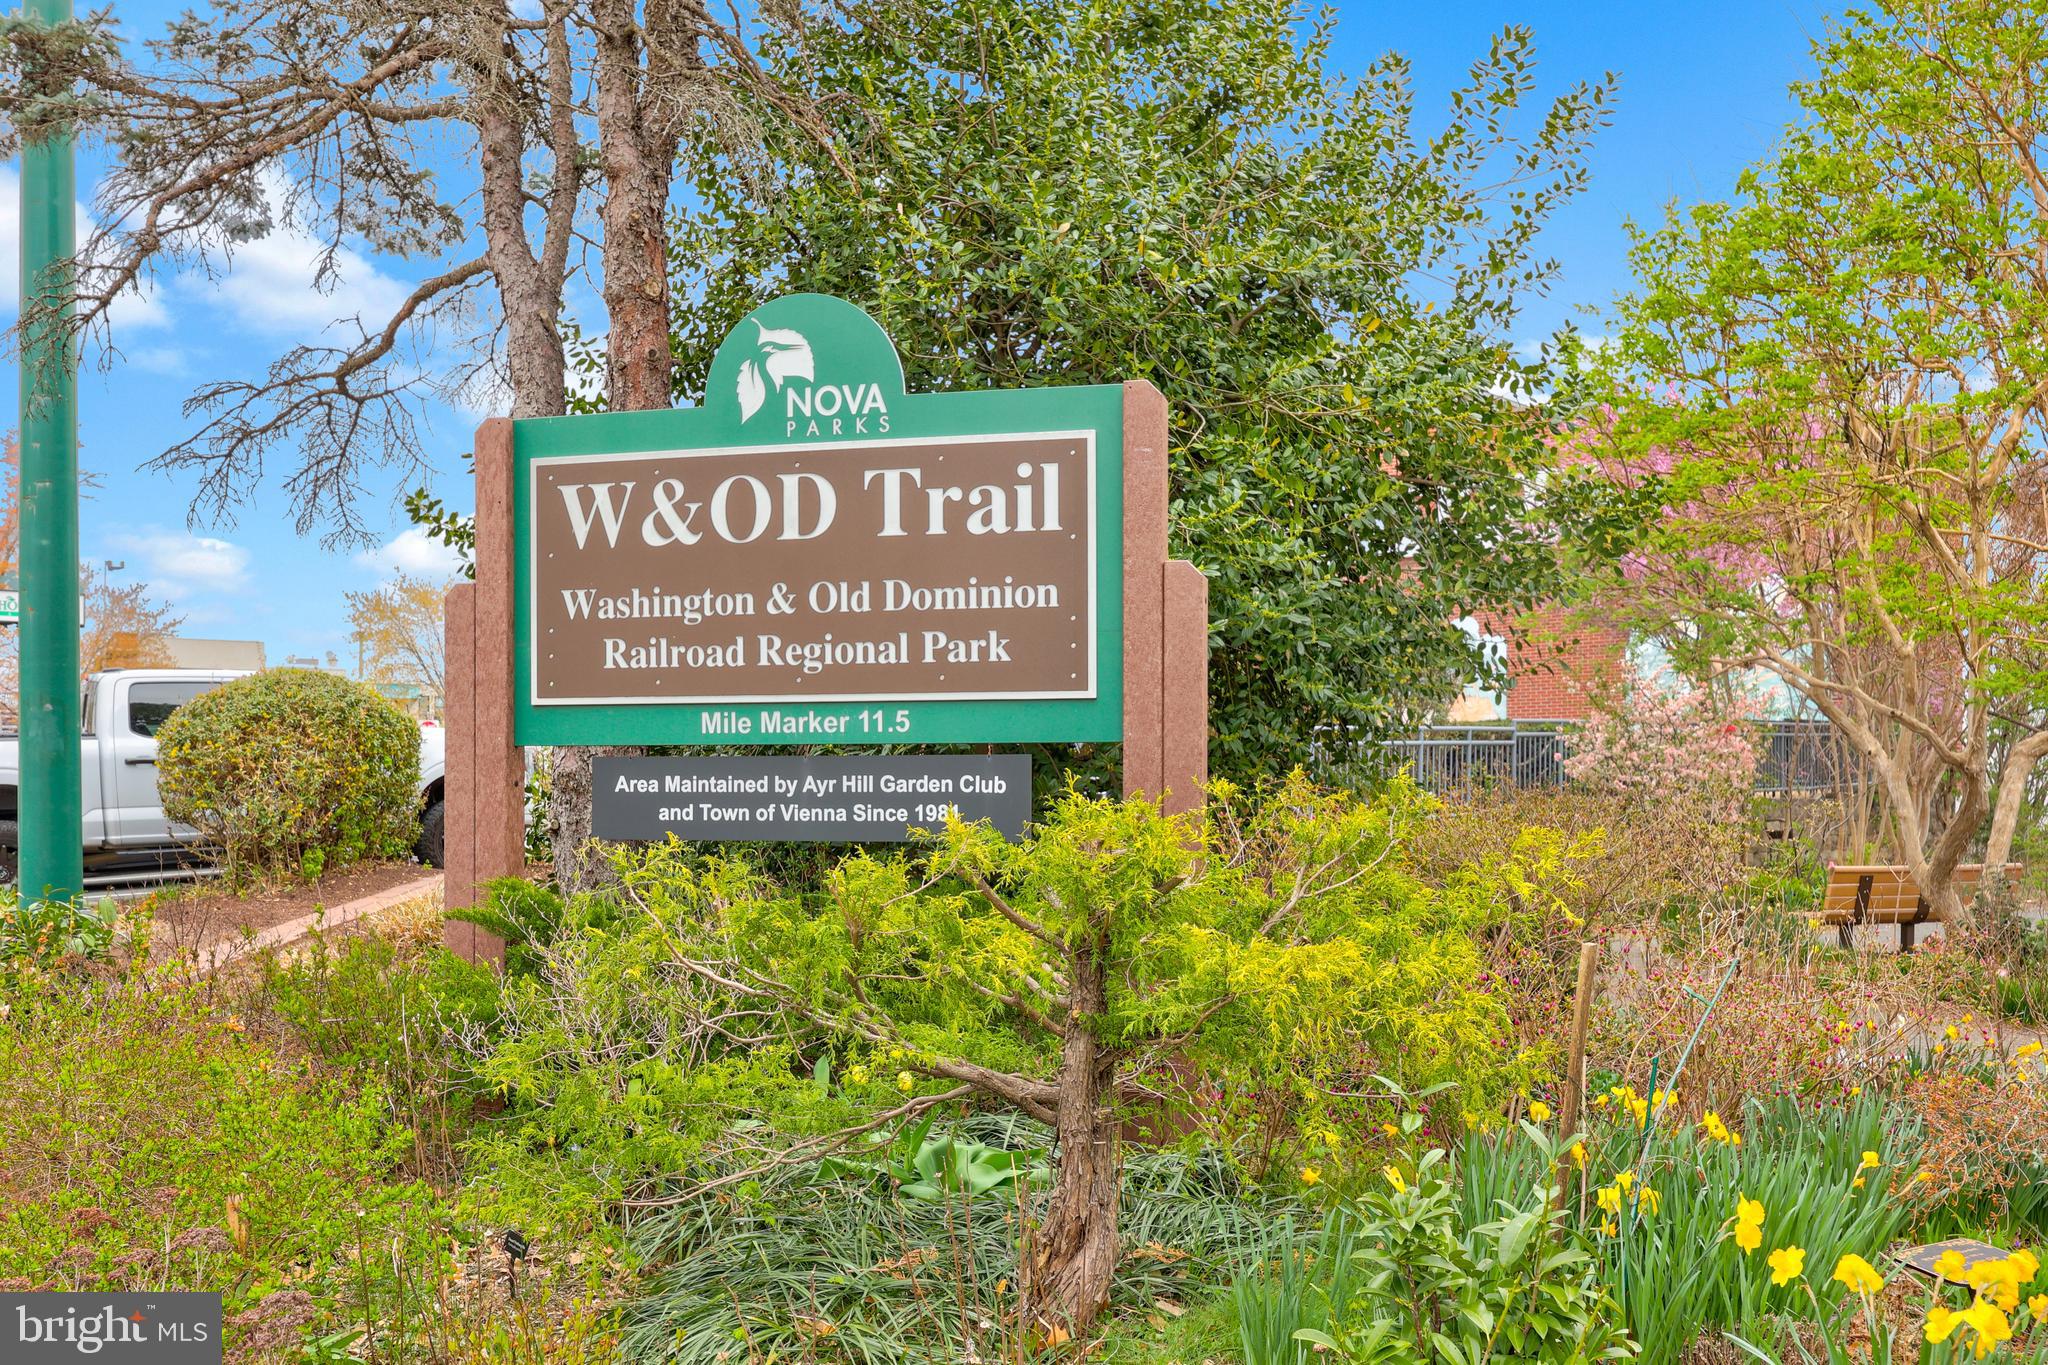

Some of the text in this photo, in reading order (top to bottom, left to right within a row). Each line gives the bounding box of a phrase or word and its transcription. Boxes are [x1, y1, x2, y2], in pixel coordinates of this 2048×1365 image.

[786, 383, 888, 417] NOVA
[787, 415, 890, 438] PARKS
[556, 462, 1064, 550] W&OD Trail
[560, 575, 1060, 626] Washington & Old Dominion
[603, 630, 1012, 674] Railroad Regional Park
[701, 709, 911, 734] Mile Marker 11.5
[614, 774, 1007, 798] Area Maintained by Ayr Hill Garden Club
[658, 803, 694, 822] and
[698, 803, 750, 822] Town
[755, 803, 777, 822] of
[779, 803, 848, 822] Vienna
[852, 803, 909, 823] Since
